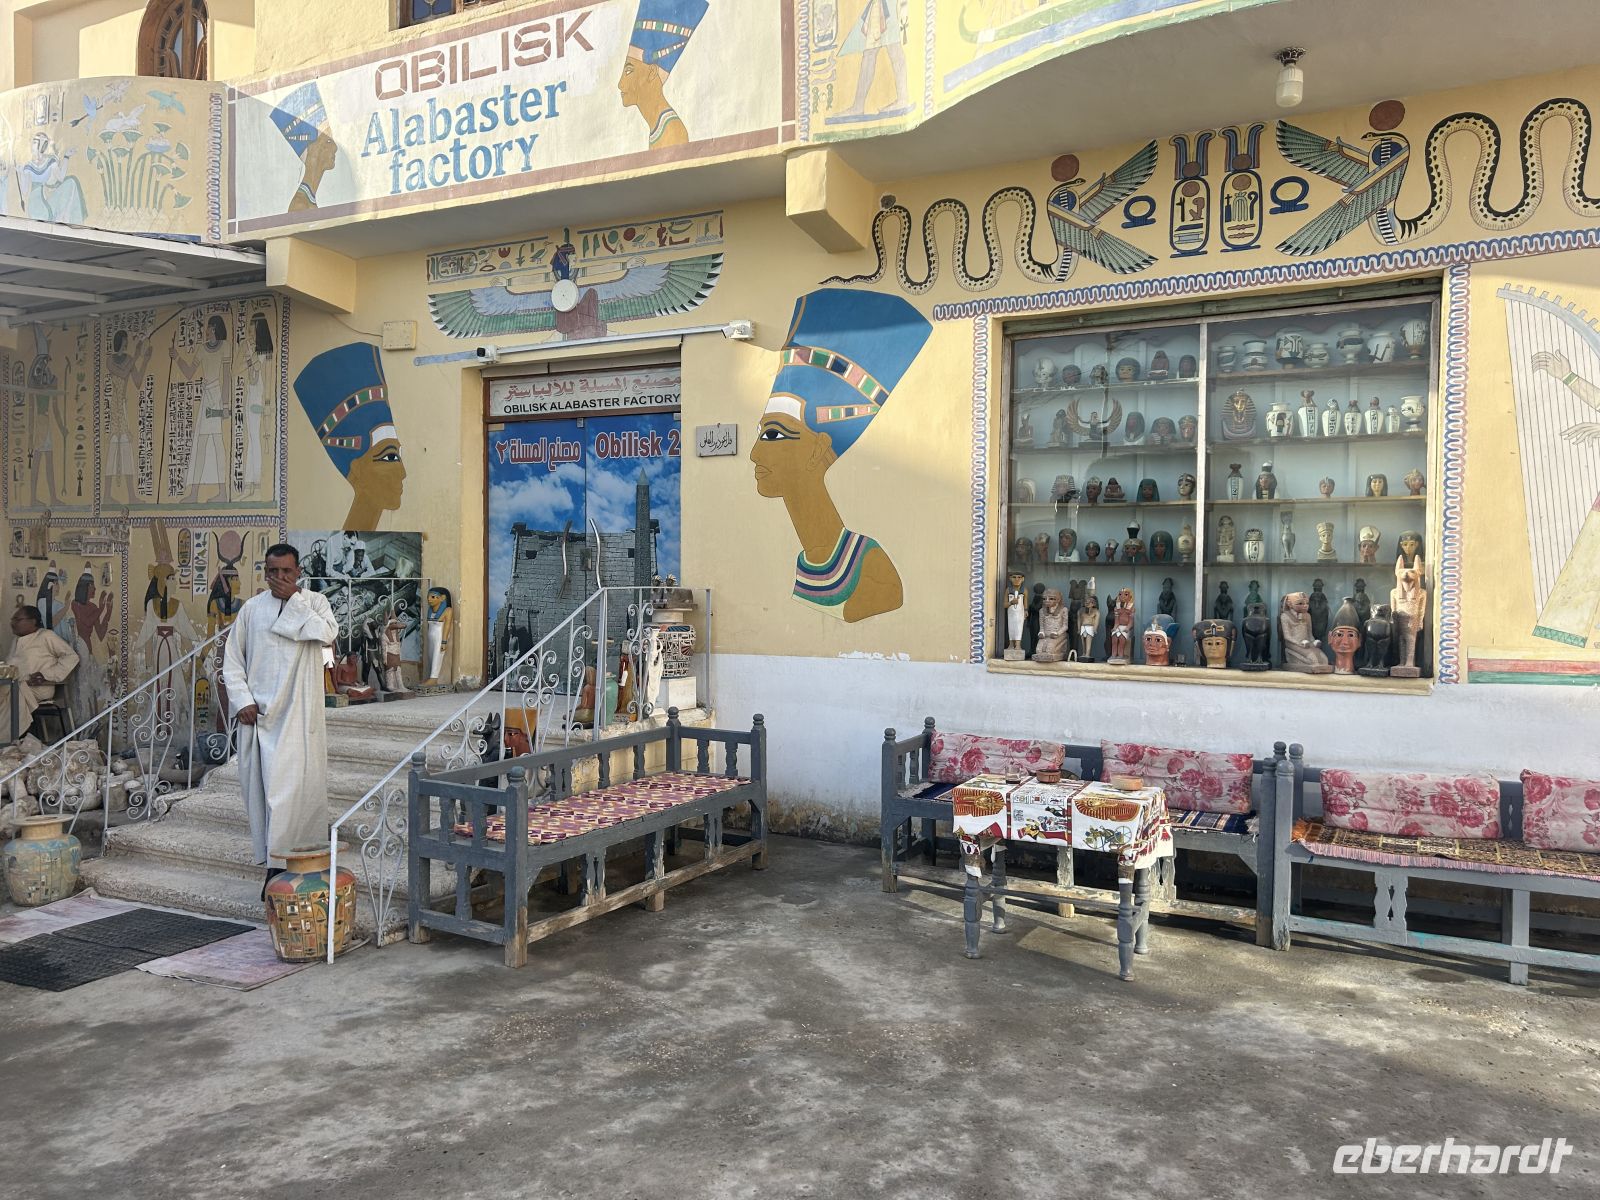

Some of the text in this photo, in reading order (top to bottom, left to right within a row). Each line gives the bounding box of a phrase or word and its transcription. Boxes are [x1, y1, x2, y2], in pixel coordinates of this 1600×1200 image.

[374, 11, 596, 100] OBILISK
[361, 80, 567, 157] Alabaster
[632, 375, 681, 395] مصنع
[503, 393, 681, 414] OBILISK ALABASTER FACTORY
[510, 437, 548, 464] المسلة
[548, 437, 581, 472] مصنع
[595, 429, 681, 459] Obilisk 2
